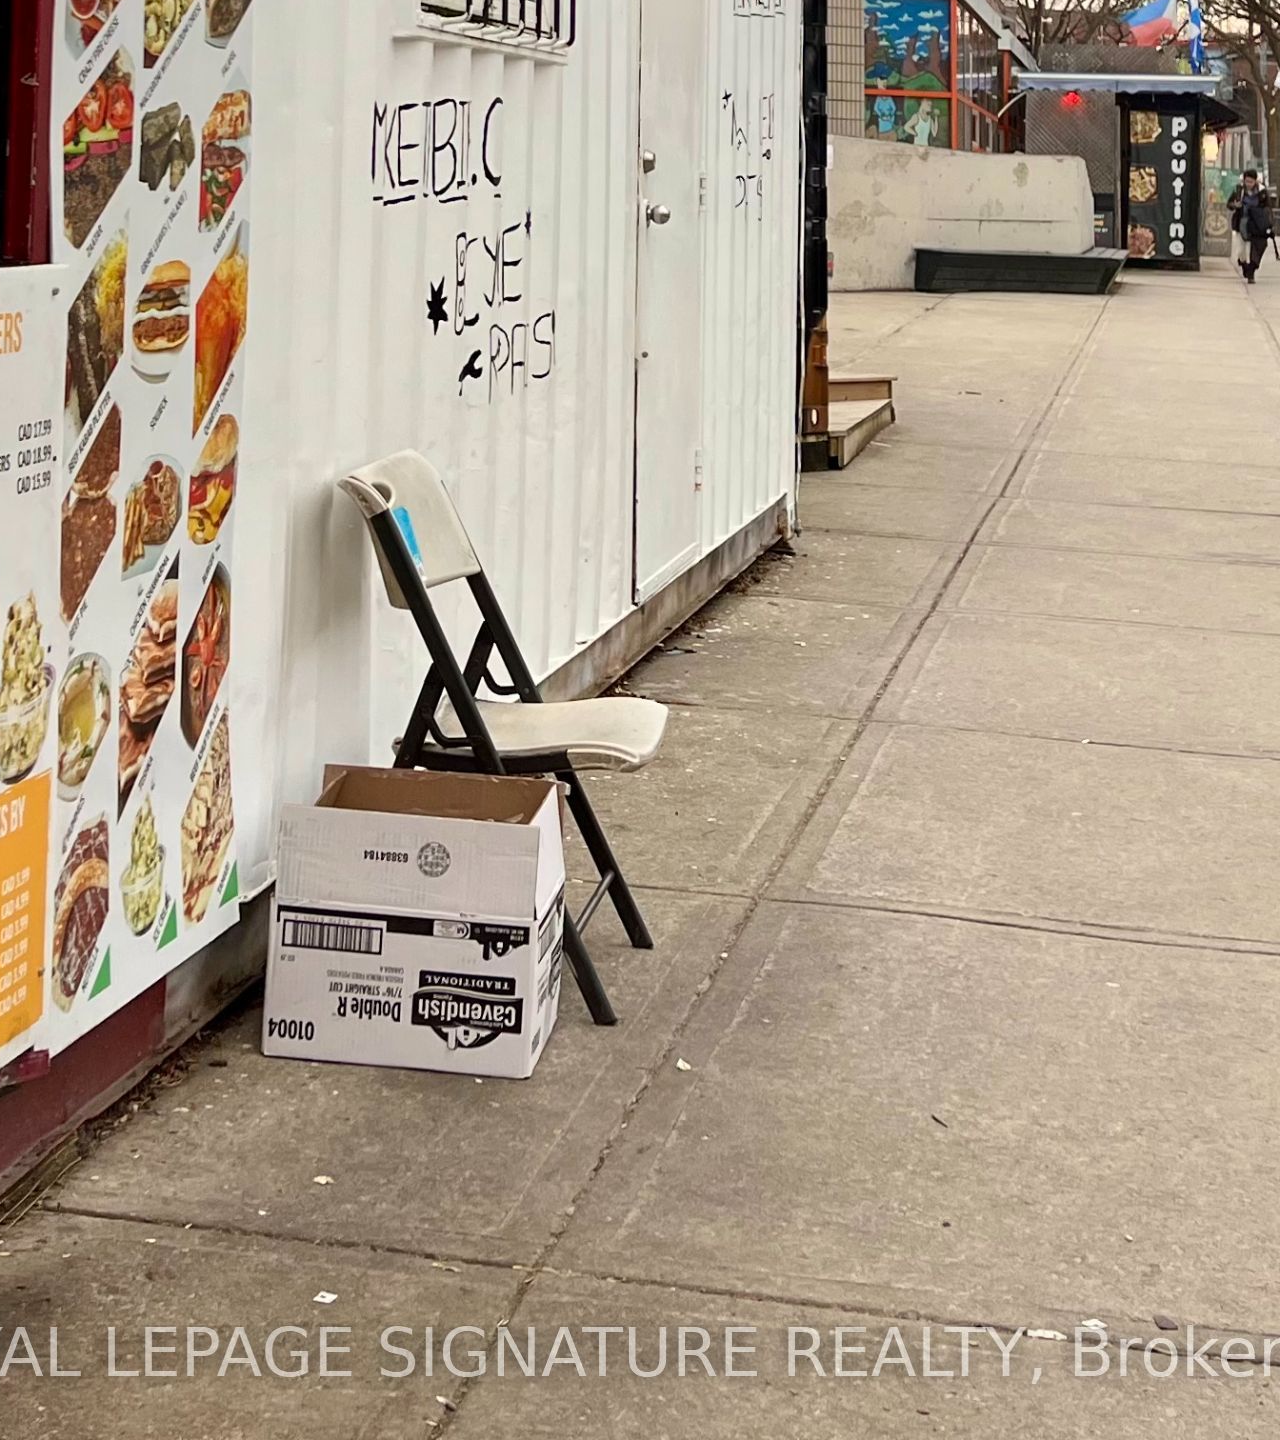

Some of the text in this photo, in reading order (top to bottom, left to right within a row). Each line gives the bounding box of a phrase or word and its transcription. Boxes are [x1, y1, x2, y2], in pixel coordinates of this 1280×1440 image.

[18, 424, 33, 443] CAD
[11, 796, 26, 834] BY
[329, 981, 344, 993] CUT
[345, 984, 380, 995] STRAIGHT
[426, 974, 510, 991] TRADITIONAL
[351, 997, 401, 1022] Double
[418, 998, 516, 1027] Cavendish
[268, 1019, 314, 1041] 01004
